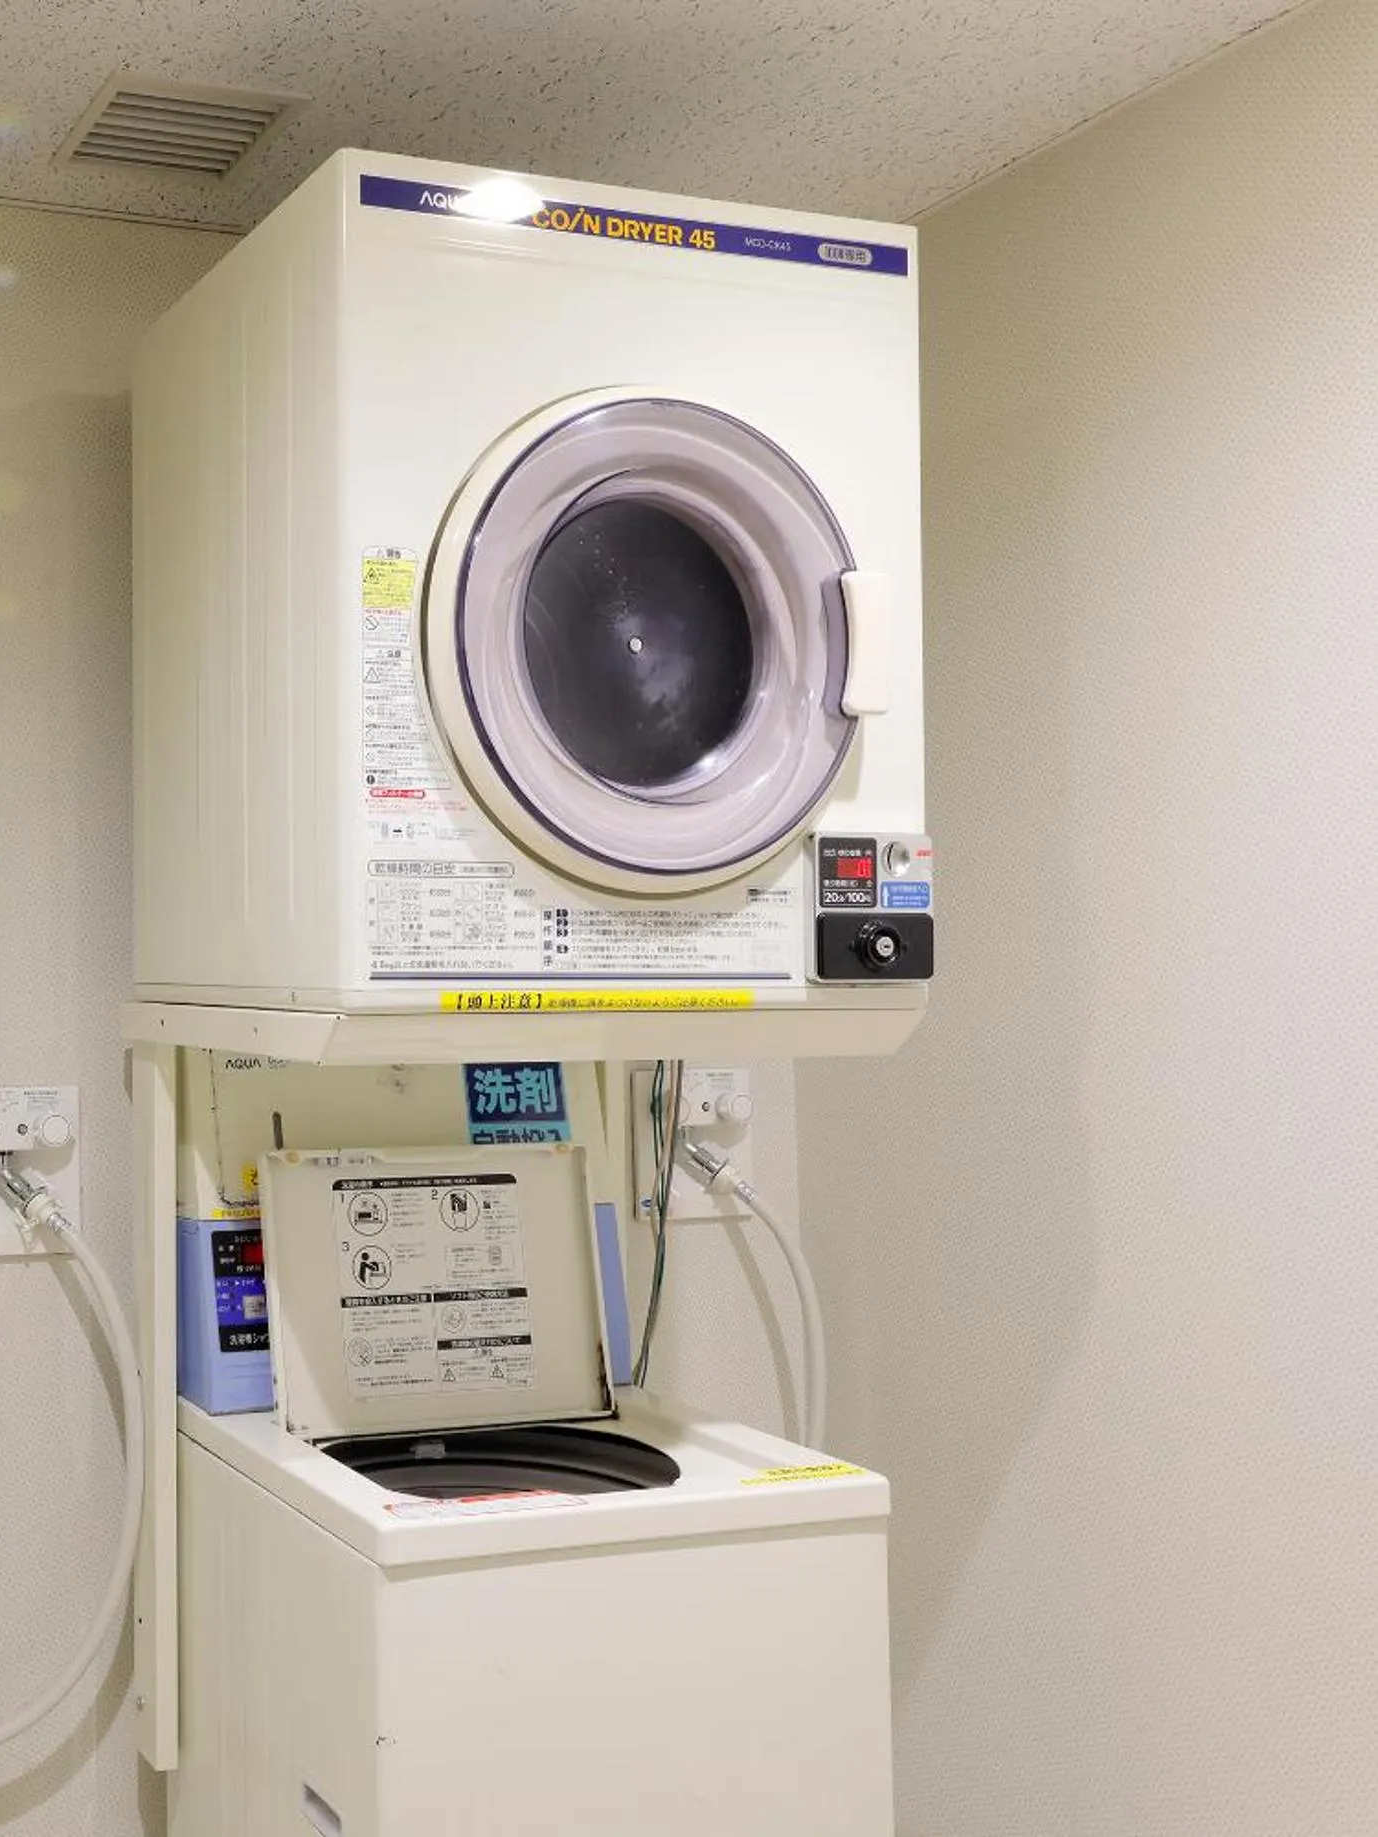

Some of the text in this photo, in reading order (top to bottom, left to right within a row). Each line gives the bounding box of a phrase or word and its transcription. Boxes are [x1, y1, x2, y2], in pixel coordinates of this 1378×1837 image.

[606, 217, 683, 246] DRYER
[688, 229, 716, 250] 45
[473, 1067, 558, 1115] 洗剤
